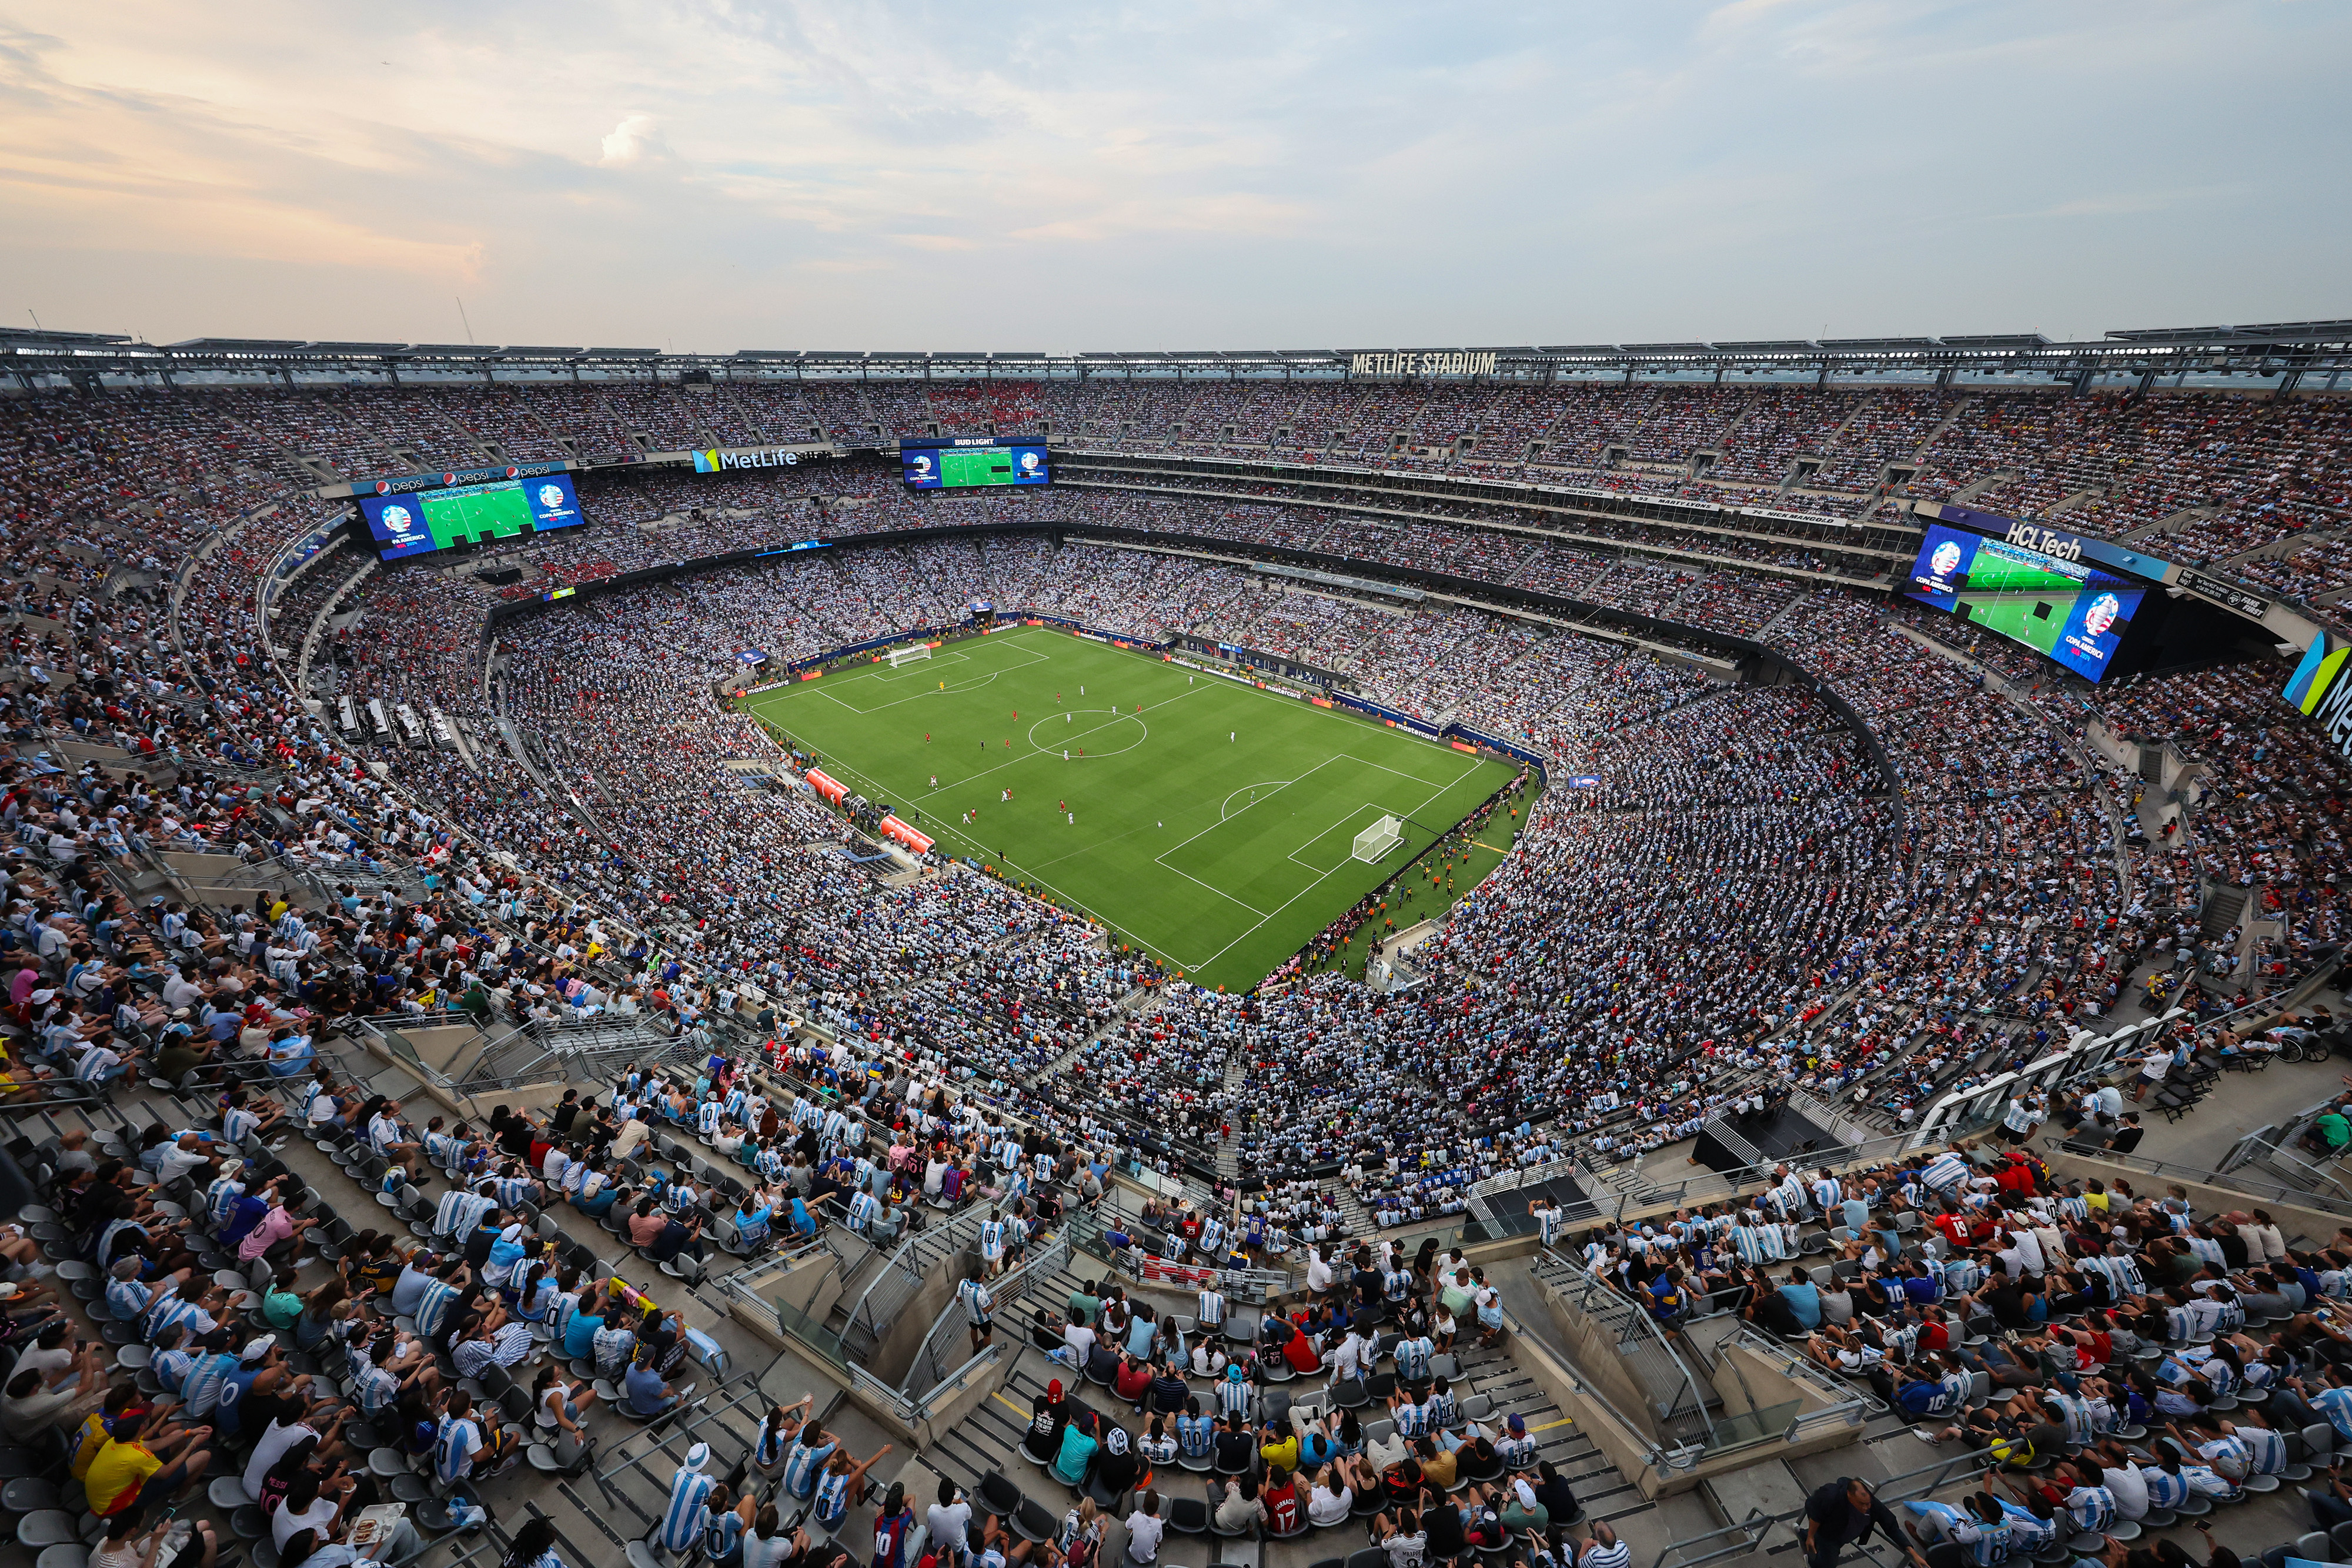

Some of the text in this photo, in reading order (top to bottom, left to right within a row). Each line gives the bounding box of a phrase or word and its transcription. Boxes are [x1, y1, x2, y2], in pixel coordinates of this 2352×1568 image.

[1352, 353, 1496, 375] METLIFE STADIUM
[720, 449, 797, 470] MetLife
[458, 470, 489, 485] pepsi
[519, 464, 550, 479] pepsi
[392, 477, 425, 493] pepsi
[400, 534, 426, 543] AMERICA
[2005, 523, 2082, 561] HCLTech
[2179, 577, 2191, 586] Help?
[2183, 570, 2194, 579] Need
[1916, 576, 1953, 593] COPA AMERICA
[2241, 596, 2260, 607] FANS
[2242, 604, 2264, 616] FIRST
[990, 621, 1018, 633] mastercard
[1080, 632, 1107, 643] mastercard
[881, 647, 915, 660] mastercard
[2066, 635, 2103, 660] COPA AMERICA
[2071, 647, 2091, 661] USA 2024
[1171, 658, 1201, 670] mastercard
[747, 679, 789, 695] mastercard
[1266, 685, 1301, 700] mastercard
[1396, 723, 1438, 742] mastercard
[702, 1109, 713, 1122] 10
[792, 1105, 799, 1115] 10
[808, 1116, 816, 1126] 10
[908, 1161, 917, 1174] 10
[1038, 1161, 1046, 1172] 10
[854, 1170, 863, 1182] 10
[850, 1202, 862, 1219] 10
[2046, 1205, 2056, 1220] 10
[1205, 1226, 1215, 1240] 10
[1250, 1221, 1259, 1234] 10
[1953, 1221, 1968, 1238] 19
[984, 1229, 996, 1244] 10
[1168, 1243, 1175, 1256] 10
[1394, 1283, 1404, 1293] 10
[1886, 1284, 1905, 1303] 10
[542, 1303, 559, 1327] 10
[1271, 1355, 1281, 1365] 10
[1411, 1353, 1424, 1369] 21
[356, 1375, 373, 1388] PAREDES
[1926, 1393, 1946, 1412] 10
[1442, 1403, 1455, 1419] 10
[1412, 1422, 1425, 1436] 10
[2073, 1411, 2092, 1433] 10
[1114, 1431, 1124, 1444] 10
[1185, 1430, 1201, 1446] 10
[1513, 1451, 1529, 1465] 10
[269, 1476, 288, 1489] MESSI
[821, 1486, 834, 1496] MESSI
[260, 1487, 283, 1516] 10
[816, 1495, 830, 1519] 10
[1278, 1507, 1295, 1533] 17
[705, 1526, 724, 1553] 10
[876, 1533, 892, 1559] 10
